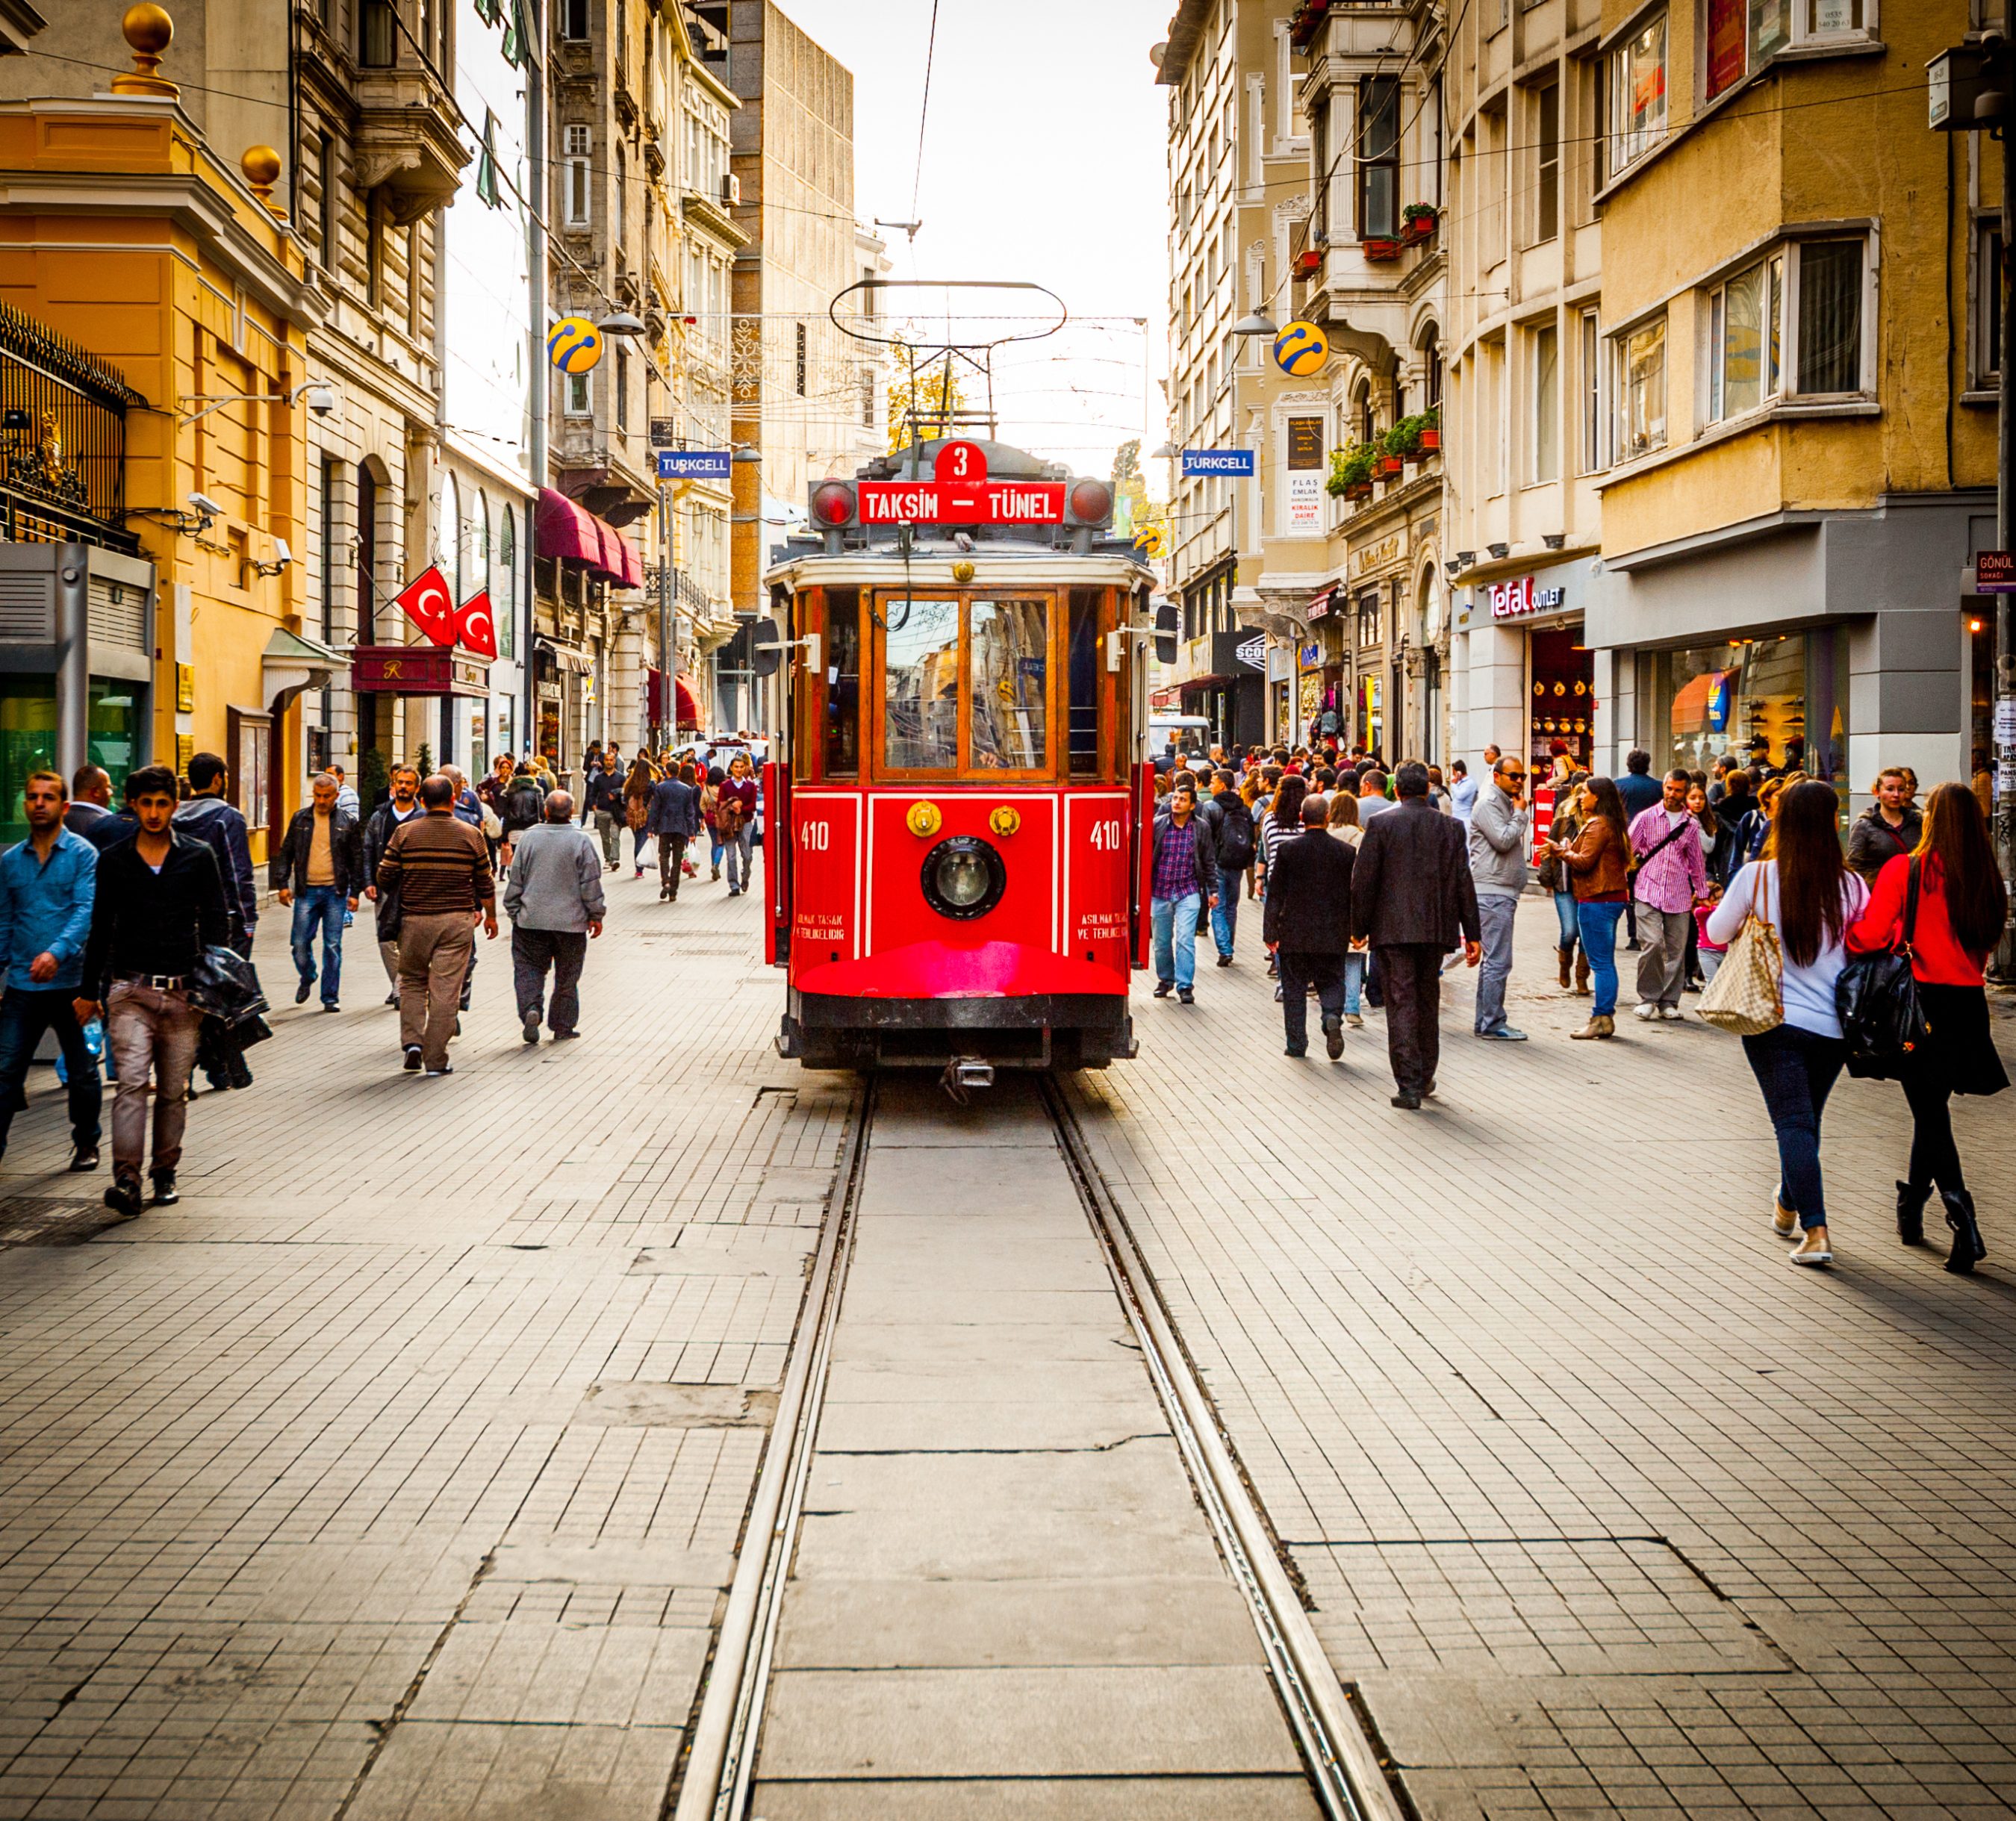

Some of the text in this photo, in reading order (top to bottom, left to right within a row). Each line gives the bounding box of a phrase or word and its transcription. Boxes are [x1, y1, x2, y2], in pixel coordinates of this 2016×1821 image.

[662, 459, 727, 471] TURKCELL
[953, 446, 968, 476] 3
[1186, 457, 1251, 470] TURKCELL
[865, 488, 938, 520] TAKSİM
[989, 489, 1057, 519] TÜNEL
[1980, 555, 2014, 569] GÖNÜL
[1488, 577, 1564, 617] Tefal OUTLET
[801, 821, 829, 850] 410
[1090, 821, 1119, 850] 410
[1077, 928, 1089, 939] VE
